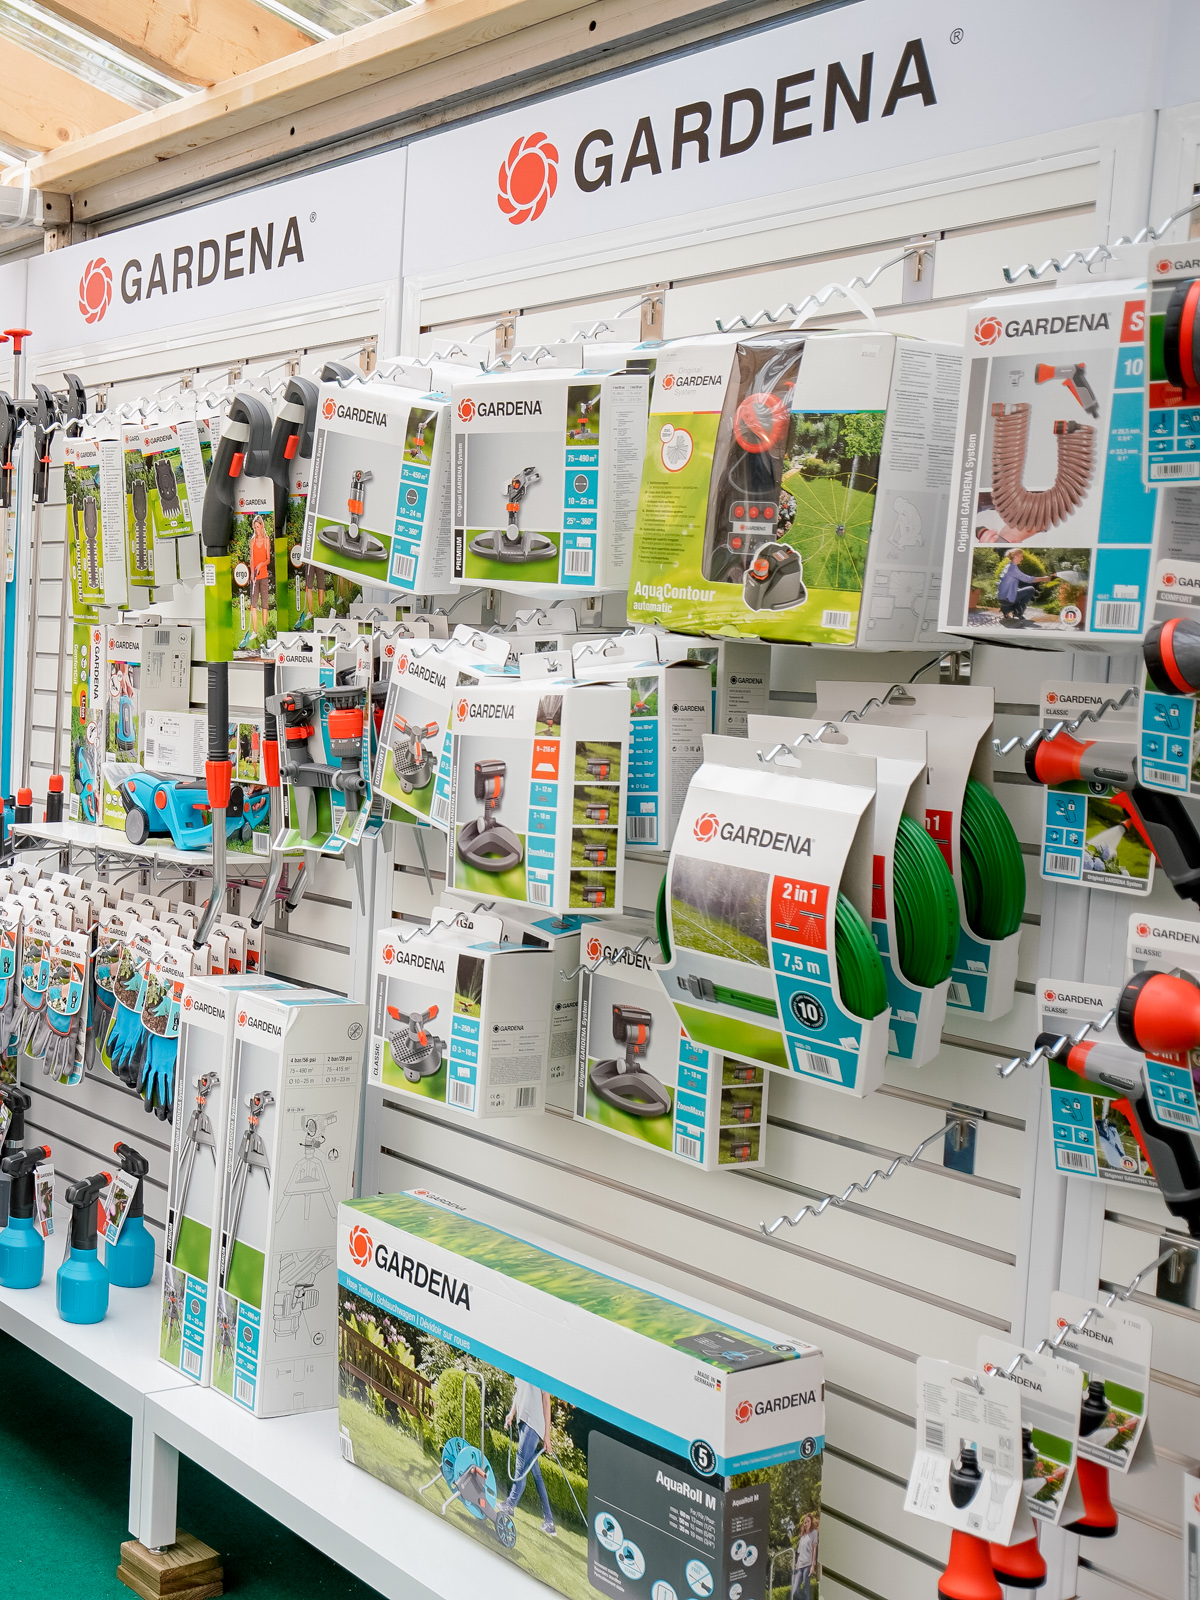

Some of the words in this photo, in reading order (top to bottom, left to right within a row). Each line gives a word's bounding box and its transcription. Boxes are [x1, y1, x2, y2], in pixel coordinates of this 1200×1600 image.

[574, 38, 937, 193] GARDENA
[121, 216, 304, 304] GARDENA
[1005, 312, 1110, 339] GARDENA
[676, 374, 722, 387] GARDENA
[674, 388, 697, 397] System
[337, 405, 388, 428] GARDENA
[477, 400, 542, 417] GARDENA
[968, 434, 978, 459] System
[962, 459, 976, 503] GARDENA
[305, 521, 314, 553] COMFORT
[957, 503, 971, 553] Original
[291, 552, 301, 560] erg
[236, 570, 248, 579] ergo
[633, 580, 716, 602] AquaContour
[1160, 592, 1194, 604] COMFORT
[632, 601, 673, 614] automatic
[115, 641, 139, 651] GARDENA
[286, 655, 313, 663] GARDENA
[408, 661, 447, 689] GARDENA
[737, 677, 763, 685] GARDENA
[1059, 695, 1103, 705] GARDENA
[470, 703, 515, 719] GARDENA
[375, 749, 386, 786] COMFORT
[720, 823, 812, 858] GARDENA
[528, 847, 554, 858] ZoomMaxx
[782, 883, 793, 900] 2
[795, 885, 807, 903] in
[810, 888, 817, 905] 1
[1152, 928, 1200, 944] GARDEN
[61, 948, 81, 959] GARDENA
[603, 945, 652, 972] GARDEN
[1135, 947, 1162, 957] CLASSIC
[396, 951, 445, 973] GARDENA
[782, 953, 804, 972] 7,5
[807, 962, 820, 975] m
[161, 966, 184, 978] GARDENA
[1057, 994, 1103, 1007] GARDENA
[194, 1000, 226, 1020] GARDENA
[798, 1001, 818, 1021] 10
[1044, 1006, 1068, 1015] CLASSIC
[248, 1018, 282, 1038] GARDENA
[677, 1101, 705, 1117] ZoomMaxx
[375, 1244, 471, 1311] GARDENA
[346, 1277, 357, 1291] Hose
[358, 1284, 374, 1300] Trolley
[376, 1292, 415, 1322] Schlauchwagen
[420, 1317, 441, 1335] Dévidoir
[443, 1329, 453, 1339] sur
[454, 1334, 471, 1350] roues
[694, 1375, 715, 1390] GERMANY
[697, 1371, 710, 1381] MADE
[755, 1390, 816, 1416] GARDENA
[805, 1441, 811, 1454] 5
[698, 1448, 708, 1468] 5
[656, 1470, 702, 1504] AquaRoll
[705, 1493, 716, 1511] M
[732, 1495, 753, 1507] AquaRoll
